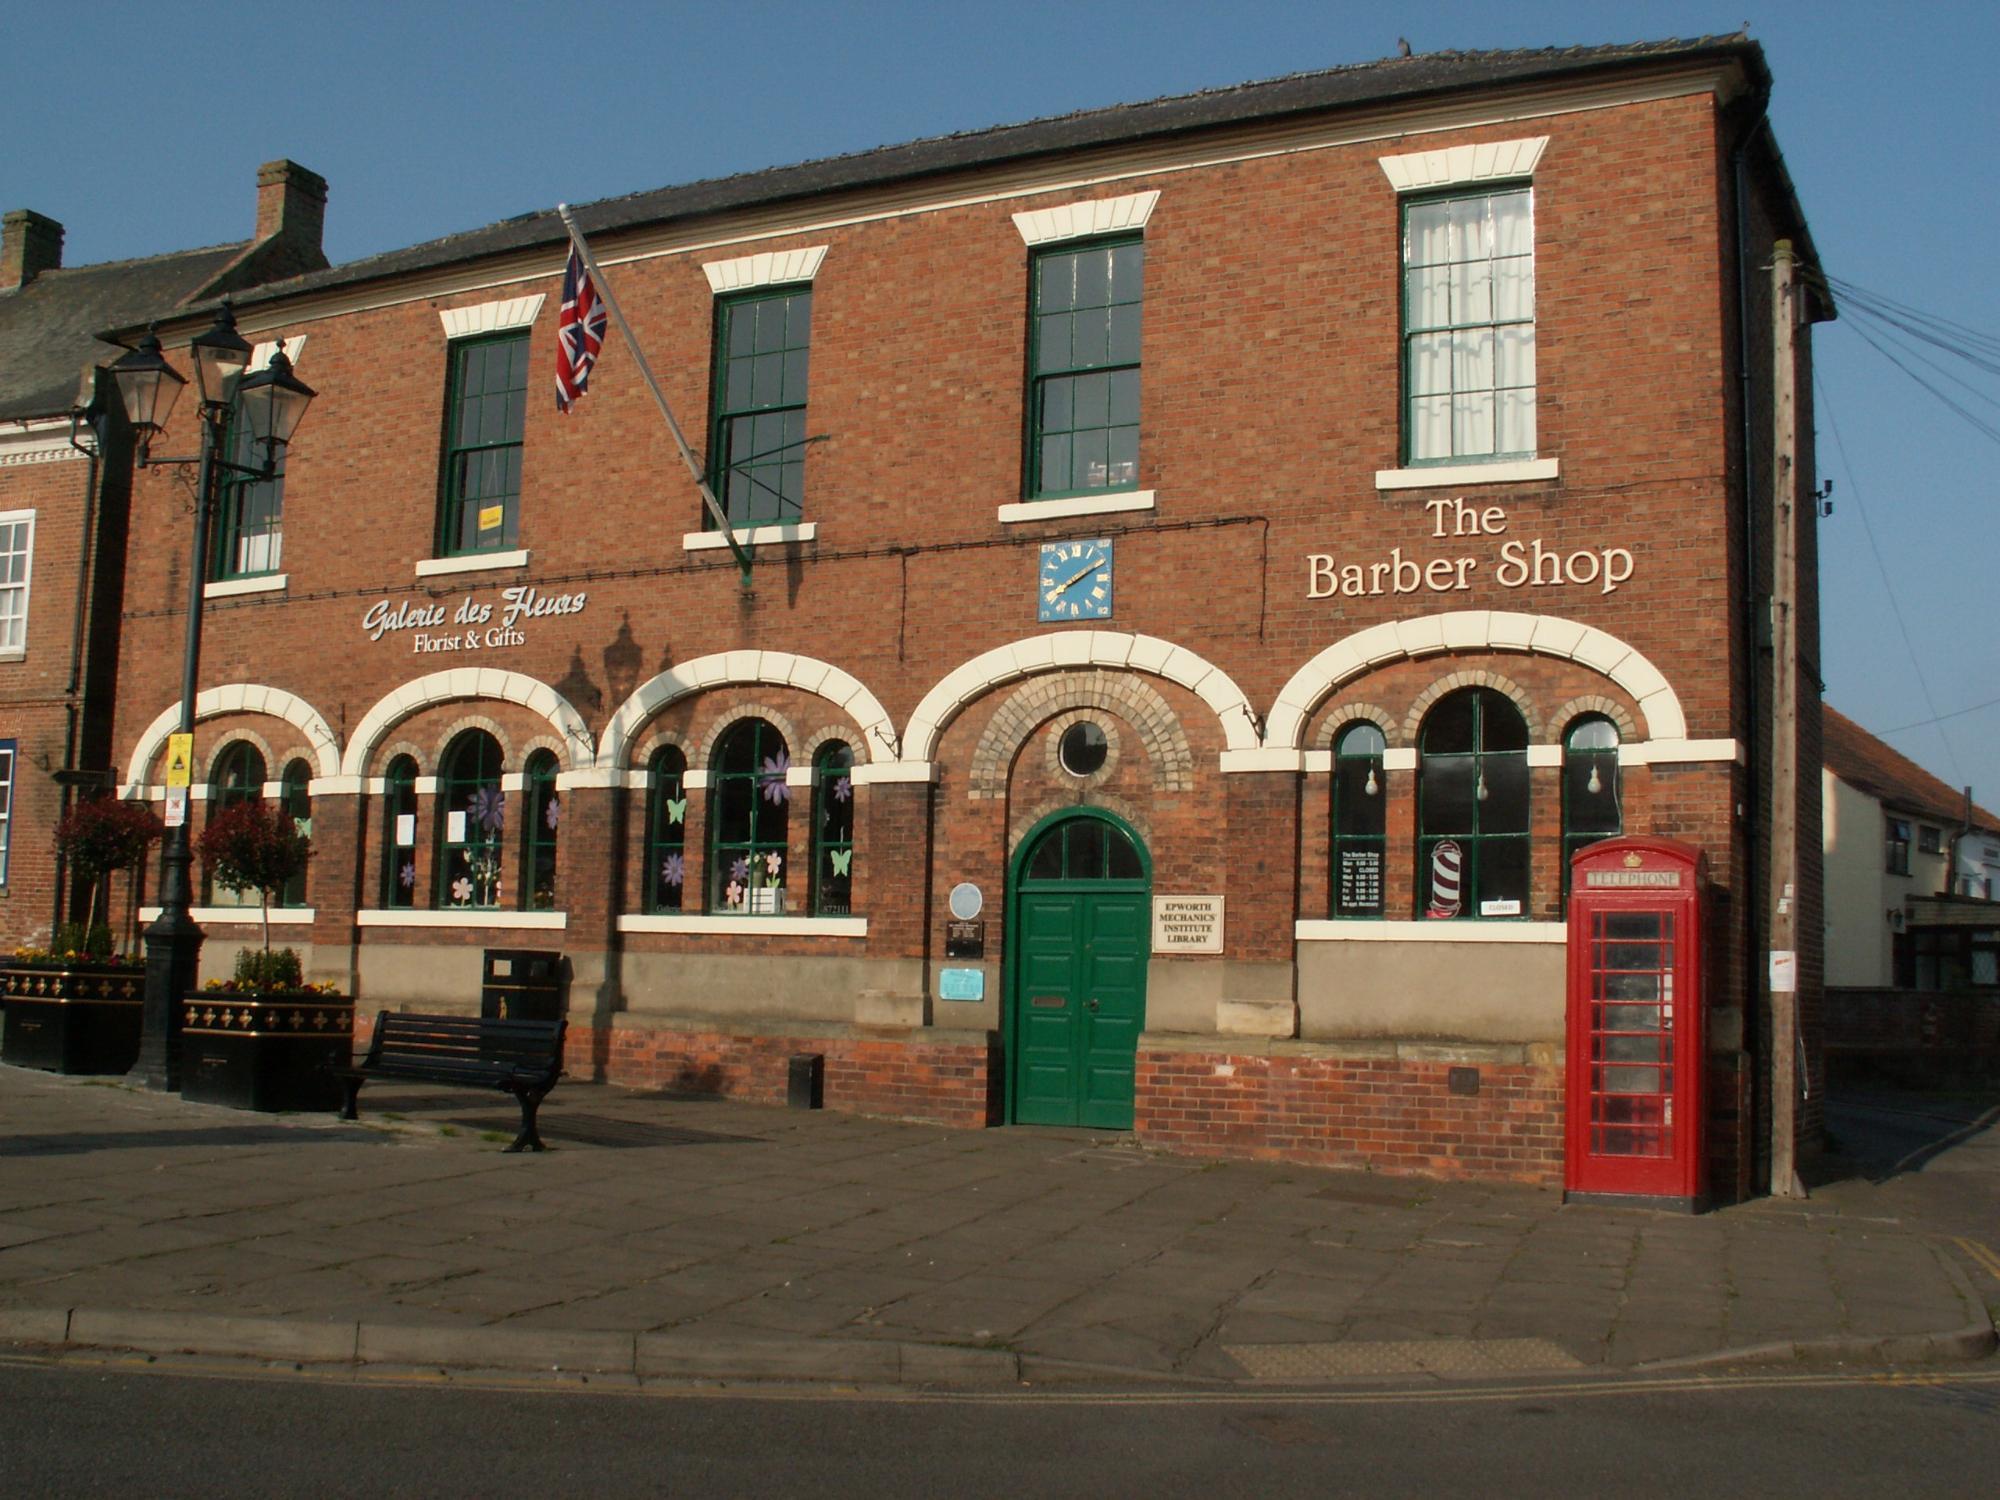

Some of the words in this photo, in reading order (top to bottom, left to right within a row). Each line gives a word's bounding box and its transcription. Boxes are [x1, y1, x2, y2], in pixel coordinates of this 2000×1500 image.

[1426, 498, 1507, 538] The
[1306, 548, 1476, 599] Barber
[1496, 539, 1635, 595] Shop
[362, 599, 446, 641] Galerie
[454, 596, 492, 625] des
[501, 586, 586, 627] Fleurs
[413, 633, 461, 653] Florist
[465, 630, 481, 650] &
[485, 627, 525, 648] Gifts
[1589, 873, 1677, 885] TELEPHONE
[1165, 903, 1212, 911] EPWORTH
[1163, 924, 1213, 933] INSTITUTE
[1167, 935, 1209, 943] LIBRARY
